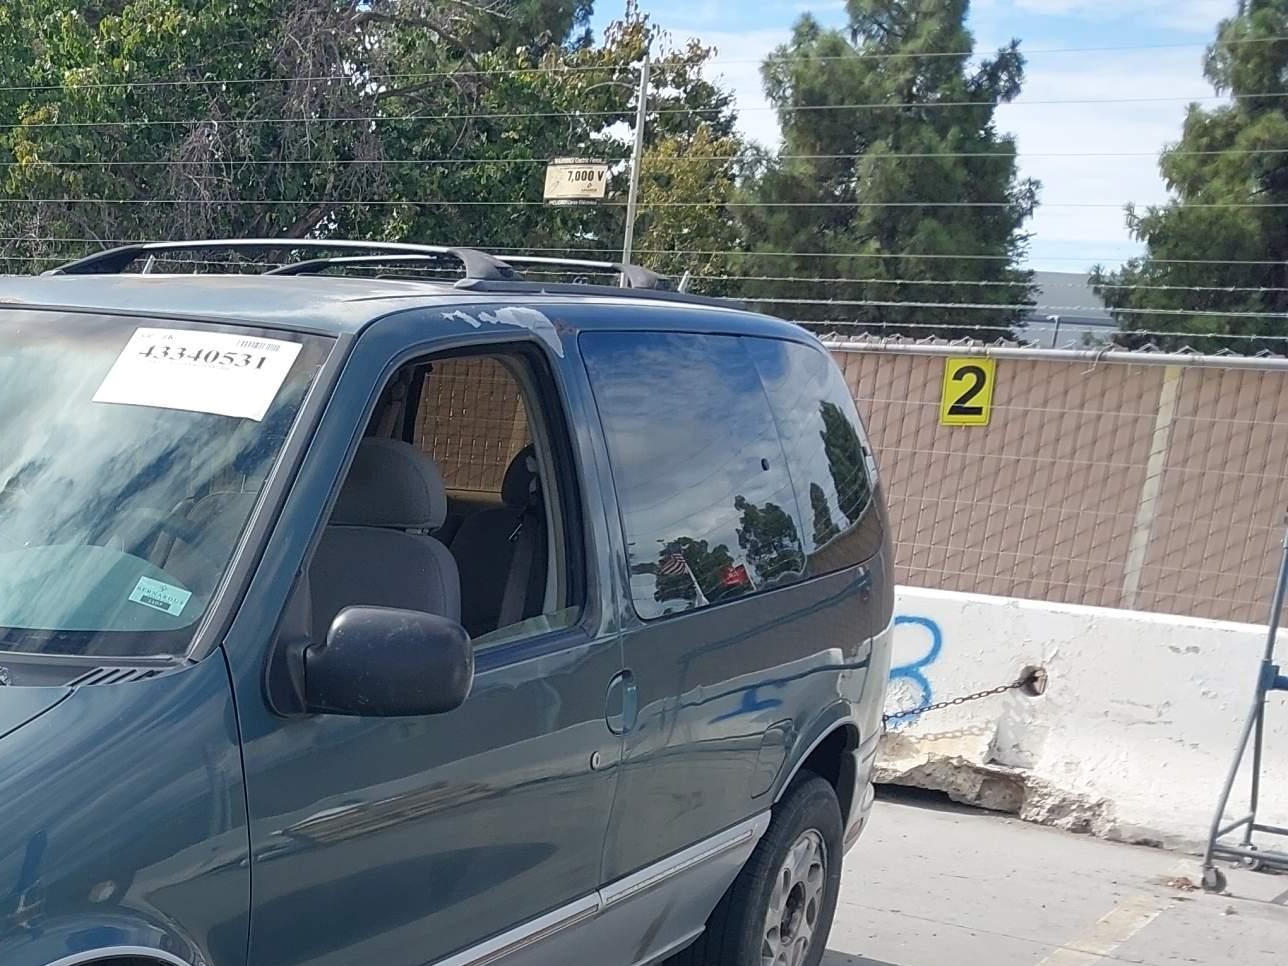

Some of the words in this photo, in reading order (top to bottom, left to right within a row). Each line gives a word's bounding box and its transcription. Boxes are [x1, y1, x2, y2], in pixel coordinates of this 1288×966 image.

[567, 170, 595, 183] 7,000
[597, 170, 605, 182] V
[138, 344, 268, 370] 43340531
[947, 365, 986, 415] 2
